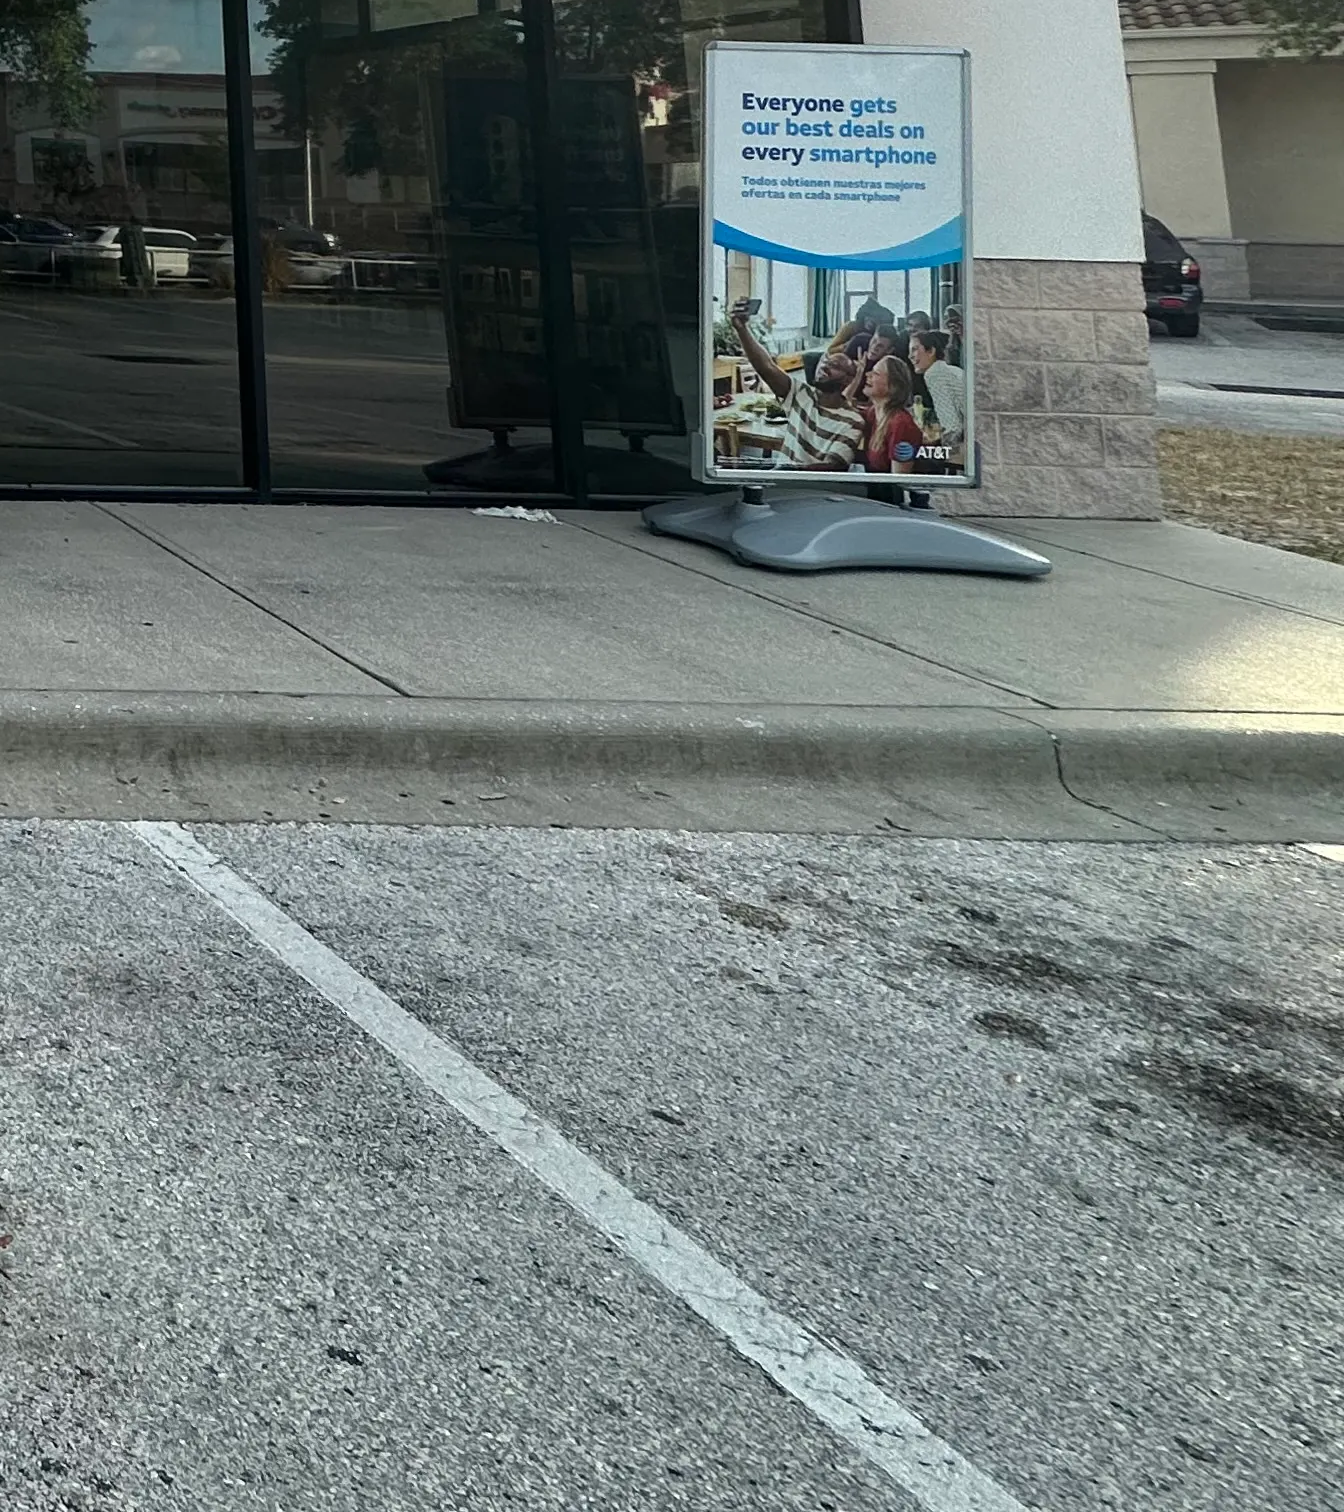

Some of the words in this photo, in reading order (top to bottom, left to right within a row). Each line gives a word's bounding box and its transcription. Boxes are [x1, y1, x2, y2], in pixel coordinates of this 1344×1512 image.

[742, 92, 845, 116] Everyone
[850, 97, 897, 117] gets
[742, 120, 780, 136] our
[785, 118, 833, 137] best
[838, 120, 895, 139] deals
[900, 124, 924, 140] on
[742, 145, 805, 166] every
[809, 146, 937, 169] smartphone
[741, 175, 778, 187] Todos
[779, 176, 831, 189] obtienen
[833, 178, 882, 190] nuestras
[885, 180, 927, 192] mejores
[741, 188, 785, 199] ofertas
[788, 191, 802, 200] en
[804, 190, 831, 201] cada
[833, 191, 901, 204] smartphone
[915, 445, 953, 460] AT&T
